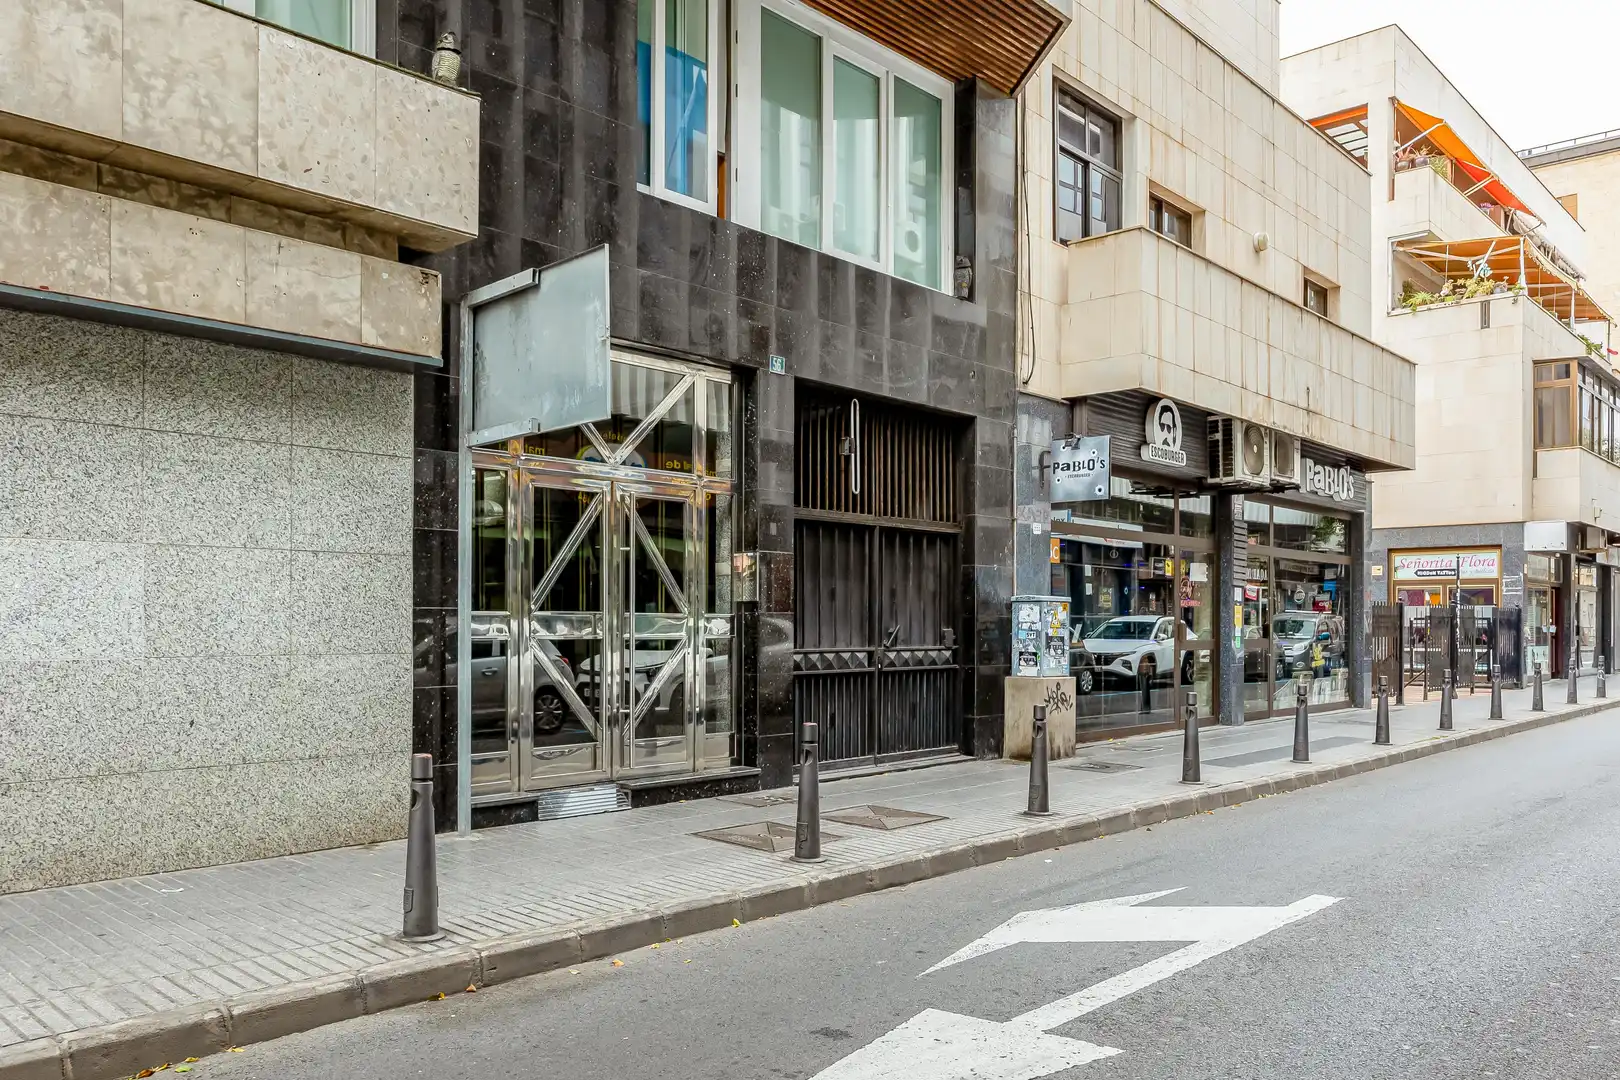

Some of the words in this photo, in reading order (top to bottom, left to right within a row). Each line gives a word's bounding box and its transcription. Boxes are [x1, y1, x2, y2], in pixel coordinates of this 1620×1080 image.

[772, 357, 782, 371] 56
[1151, 445, 1185, 464] ESCOBURGER
[1400, 557, 1453, 569] Señorita
[1460, 555, 1496, 568] Flora
